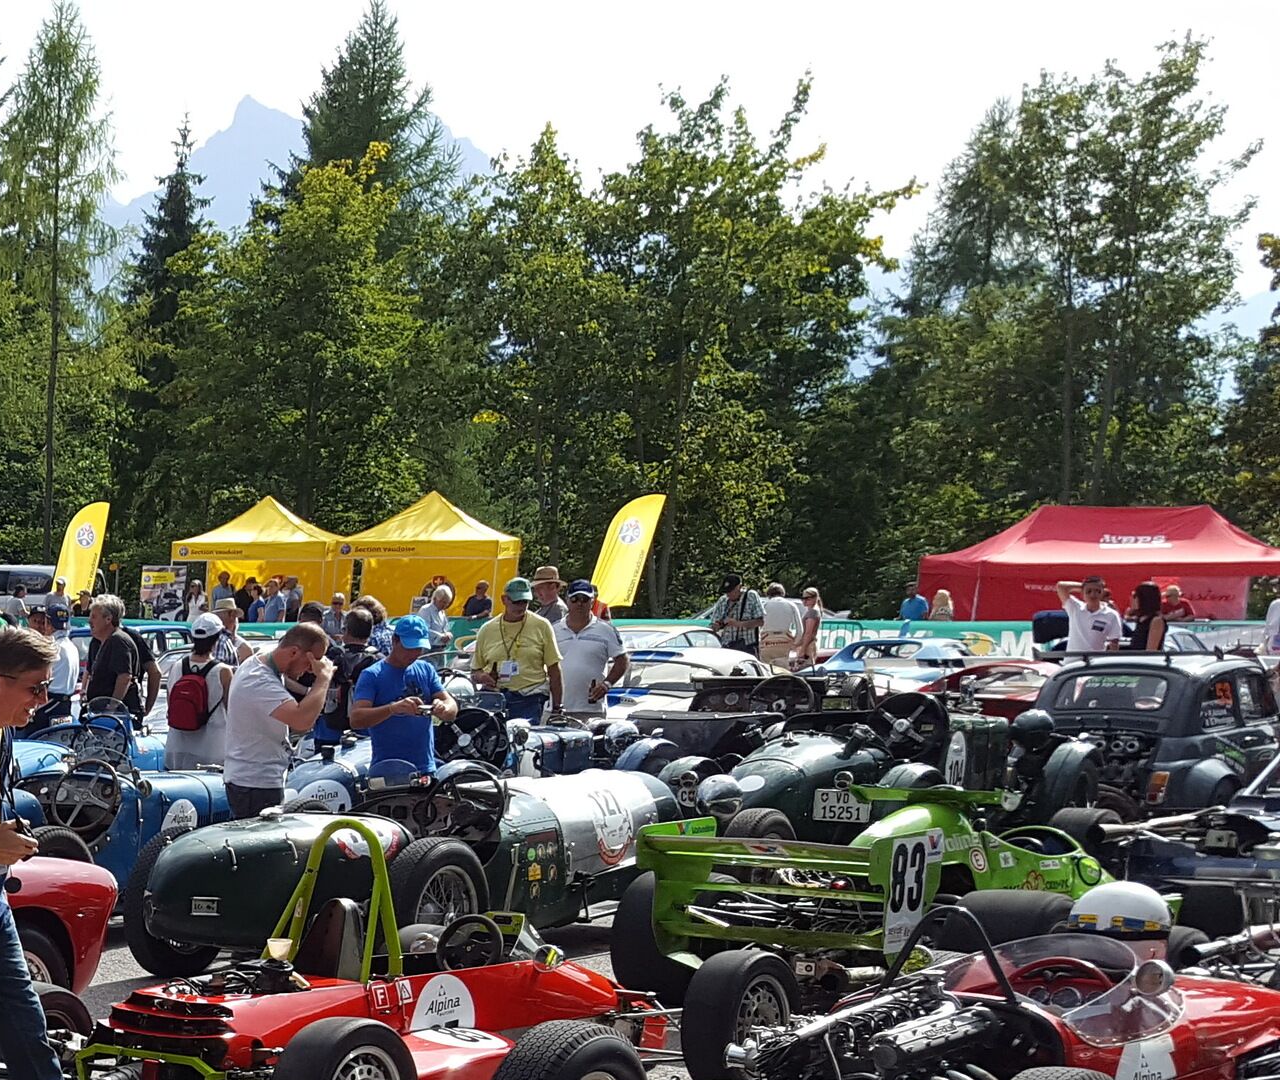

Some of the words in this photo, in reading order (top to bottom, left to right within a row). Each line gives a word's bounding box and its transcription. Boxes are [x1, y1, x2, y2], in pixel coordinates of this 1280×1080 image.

[837, 794, 849, 803] VD
[171, 814, 192, 823] Alpina
[821, 805, 861, 820] 15251
[890, 841, 927, 912] 83
[425, 996, 460, 1016] Alpina
